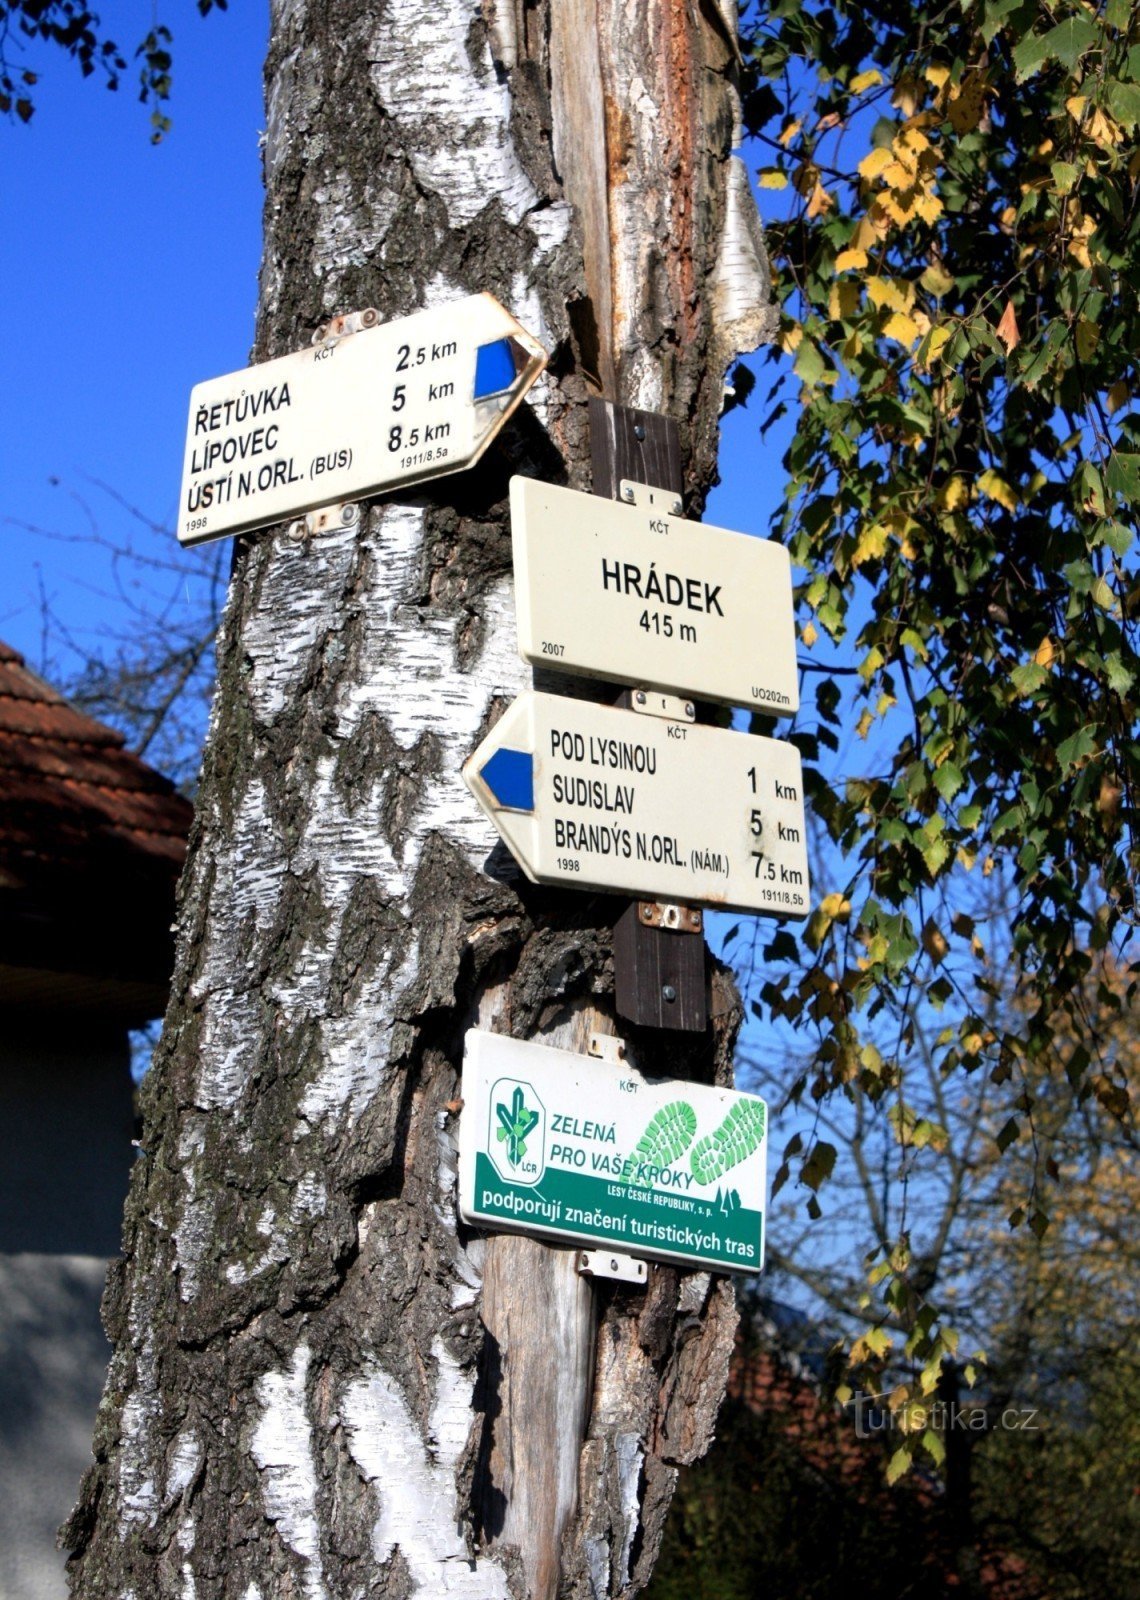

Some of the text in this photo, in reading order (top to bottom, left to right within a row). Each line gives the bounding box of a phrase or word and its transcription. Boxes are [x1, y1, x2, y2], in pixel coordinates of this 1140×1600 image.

[195, 341, 457, 436] ŘETŮVKA 2.5 km
[191, 381, 455, 475] LÍPOVEC 5 km
[187, 422, 451, 513] ÚSTÍ N.ORL. (BUS) 8.5 km
[400, 447, 449, 469] 1911/8,5a
[186, 516, 208, 532] 1998
[649, 520, 670, 535] KČT
[602, 558, 724, 617] HRÁDEK
[639, 609, 697, 643] 415 m
[541, 641, 565, 657] 2007
[751, 686, 790, 705] UO202m
[667, 725, 687, 741] KČT
[551, 729, 798, 801] POD LYSINOU 1 km
[553, 774, 800, 843] SUDISLAV 5 km
[554, 818, 803, 885] BRANDÝS N.ORL. (NÁM.) 7.5 km
[557, 857, 580, 873] 1998
[761, 888, 805, 907] 1911/8,5b
[550, 1113, 617, 1145] ZELENÁ
[549, 1143, 695, 1190] PRO VAŠE KROKY
[607, 1184, 627, 1198] LESY
[627, 1186, 652, 1204] ČESKÉ
[653, 1194, 697, 1215] REPUBLIKY,
[482, 1190, 755, 1258] podporují značení turistických tras
